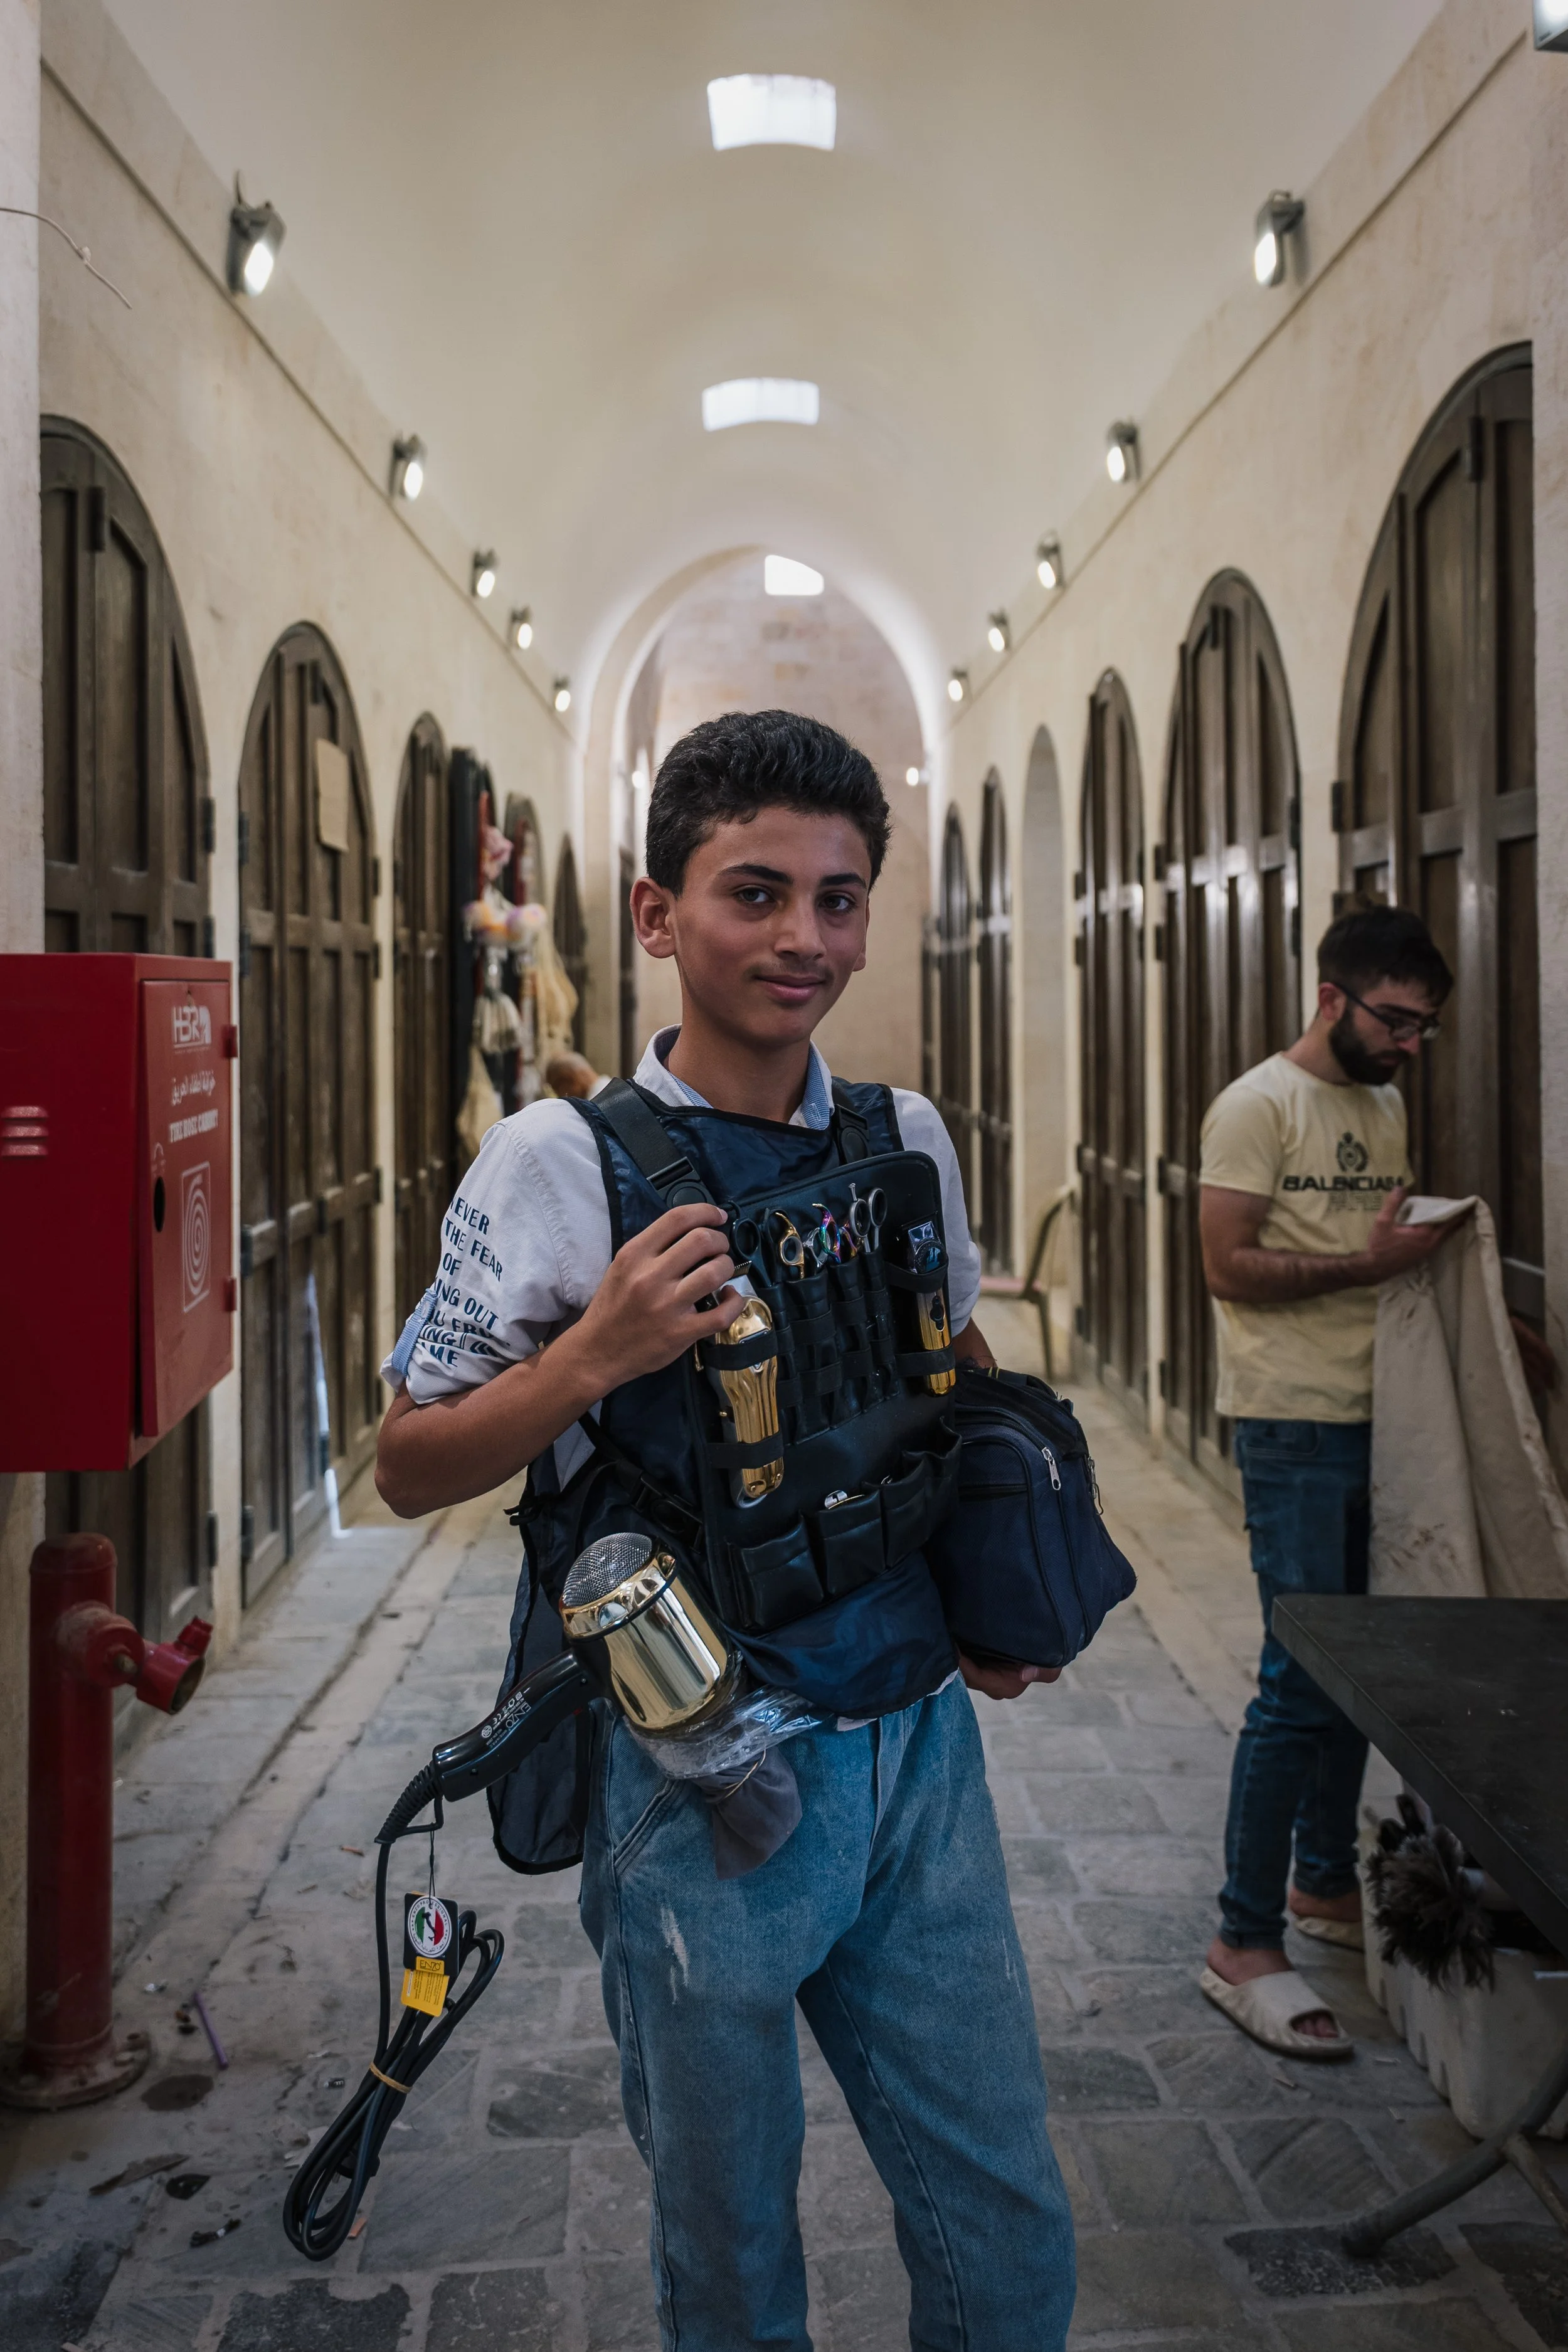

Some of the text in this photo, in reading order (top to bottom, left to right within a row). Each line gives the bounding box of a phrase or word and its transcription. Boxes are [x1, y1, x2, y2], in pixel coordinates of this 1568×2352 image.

[170, 1120, 183, 1143] FIRE
[183, 1116, 198, 1139] HOSE
[450, 1196, 490, 1235] EVER
[445, 1217, 503, 1282] THE FEAR
[442, 1252, 462, 1276] OF
[434, 1276, 499, 1330] ING OUT
[421, 1342, 460, 1368] ME
[506, 1702, 531, 1728] ENZO
[420, 1900, 448, 1926] PROESSIONAL
[420, 1960, 440, 1971] ENZO
